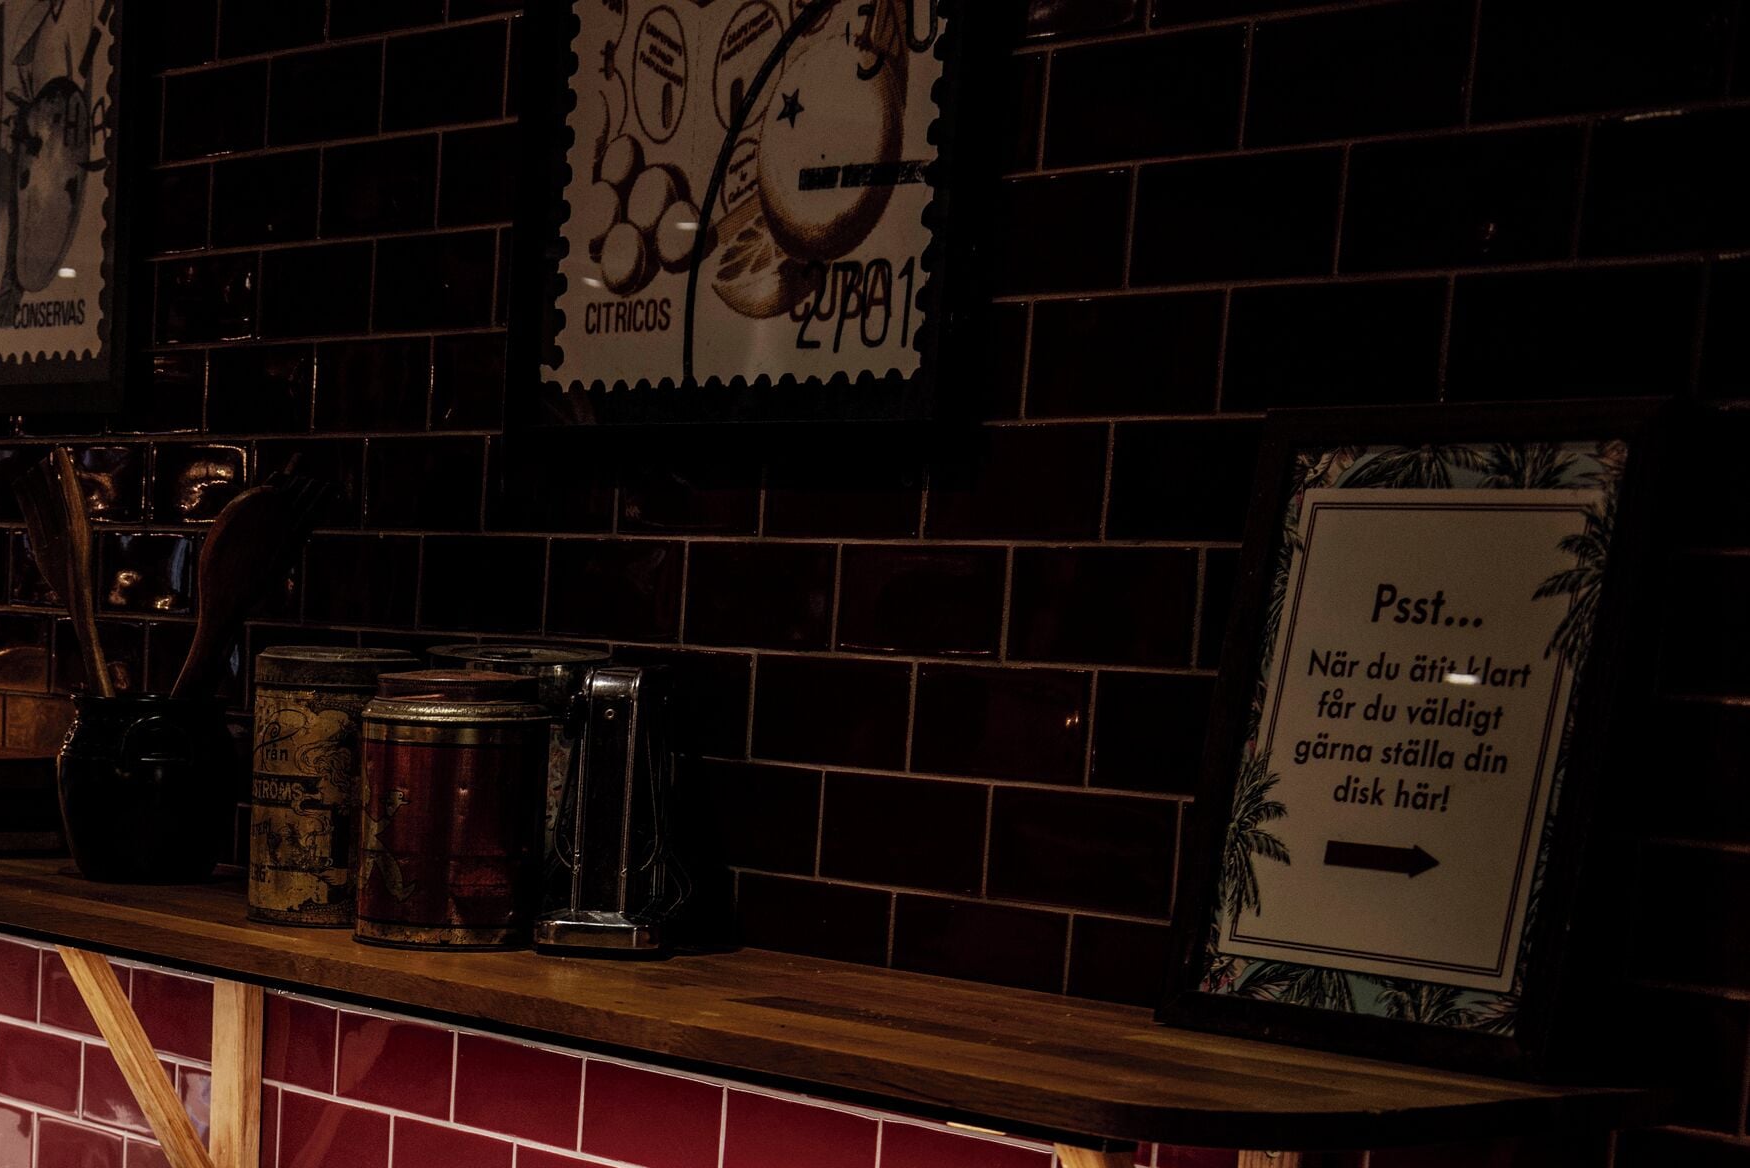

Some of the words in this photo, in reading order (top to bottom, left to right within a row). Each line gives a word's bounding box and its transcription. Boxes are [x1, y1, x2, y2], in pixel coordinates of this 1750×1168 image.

[12, 298, 86, 330] CONSERVAS
[584, 297, 672, 335] CITRICOS
[1370, 583, 1483, 628] Psst...
[1307, 648, 1360, 679] När
[1366, 651, 1401, 682] du
[1409, 654, 1457, 684] ätit
[1466, 655, 1532, 688] klart
[1316, 687, 1357, 720] får
[1362, 693, 1397, 722] du
[1406, 697, 1504, 737] väldigt
[1293, 732, 1373, 765] gärna
[1380, 738, 1455, 770] ställa
[1463, 742, 1509, 774] din
[1332, 774, 1386, 807] disk
[1393, 778, 1451, 813] här!
